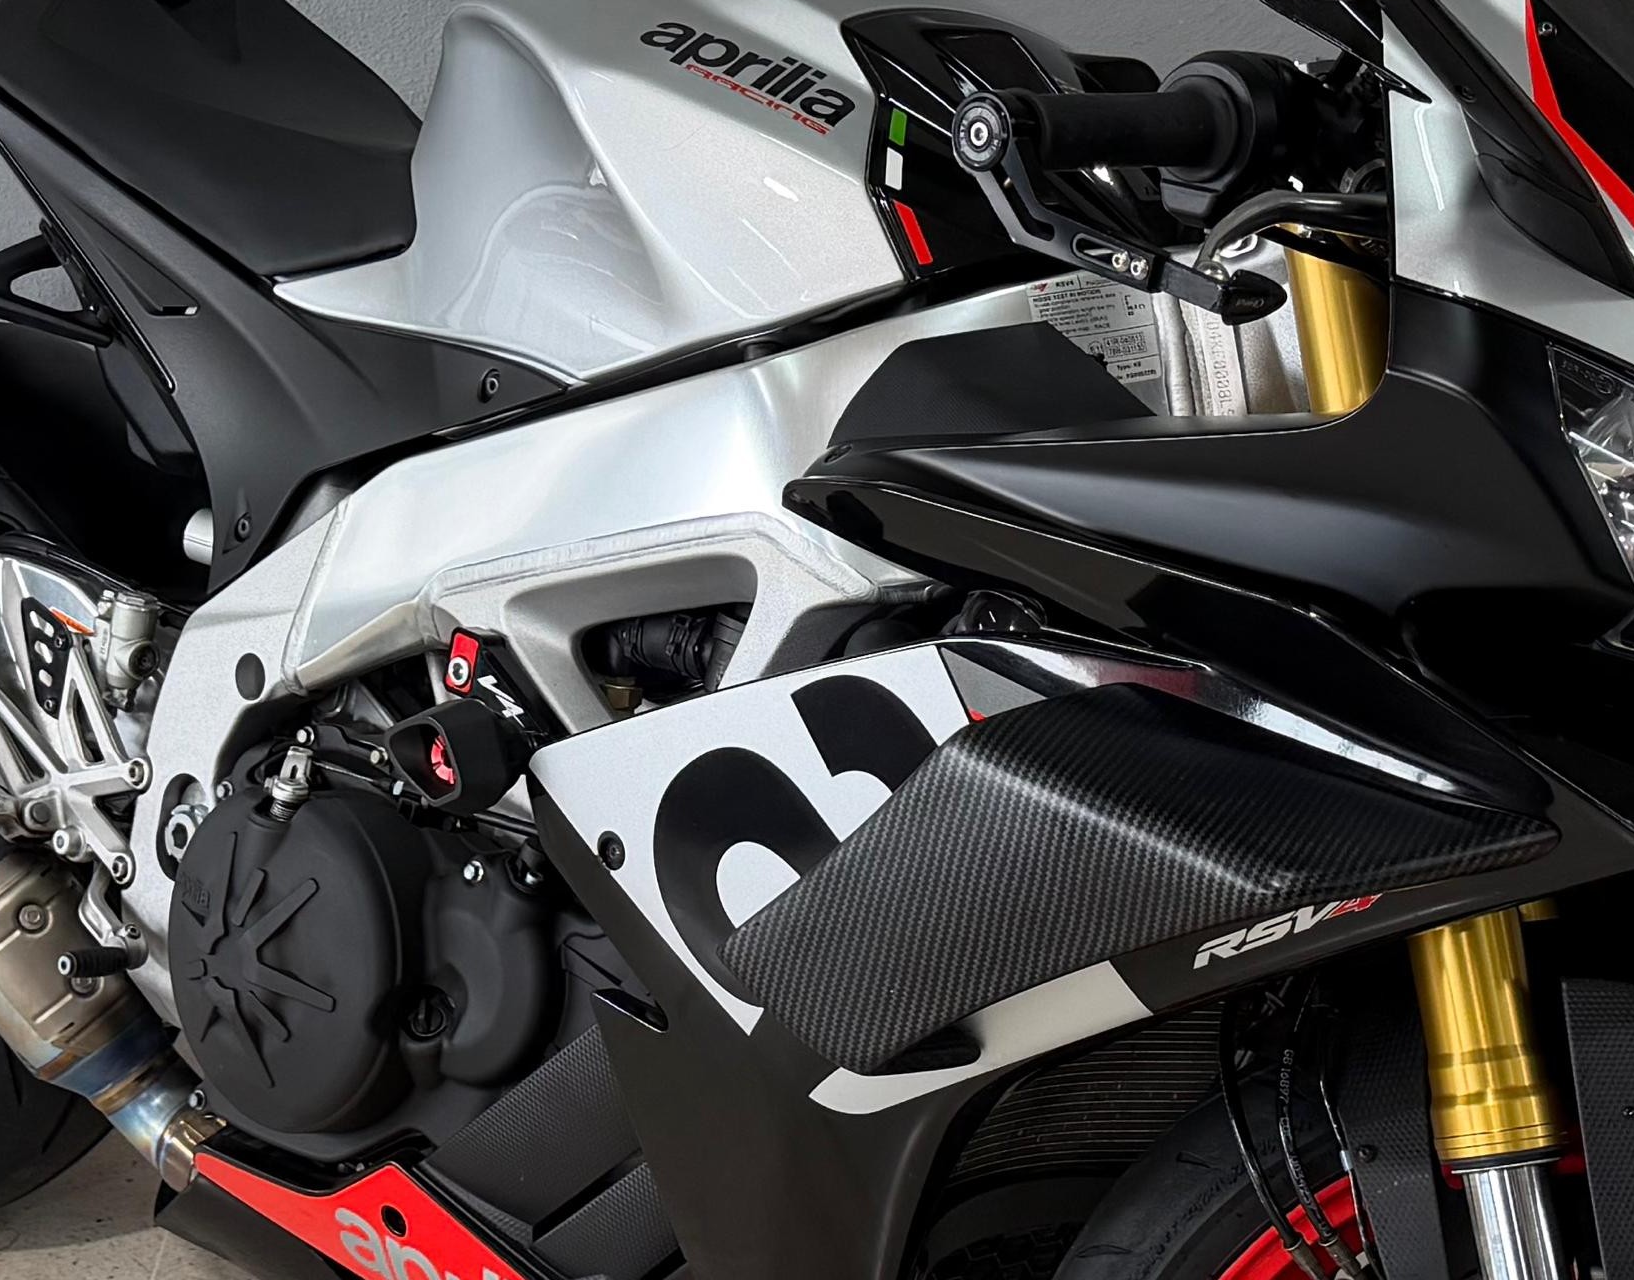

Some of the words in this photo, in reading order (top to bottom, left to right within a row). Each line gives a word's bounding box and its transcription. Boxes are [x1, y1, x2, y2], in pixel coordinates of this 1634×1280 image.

[639, 21, 856, 128] aprilia
[477, 674, 525, 728] V4
[1193, 893, 1383, 969] RSV4
